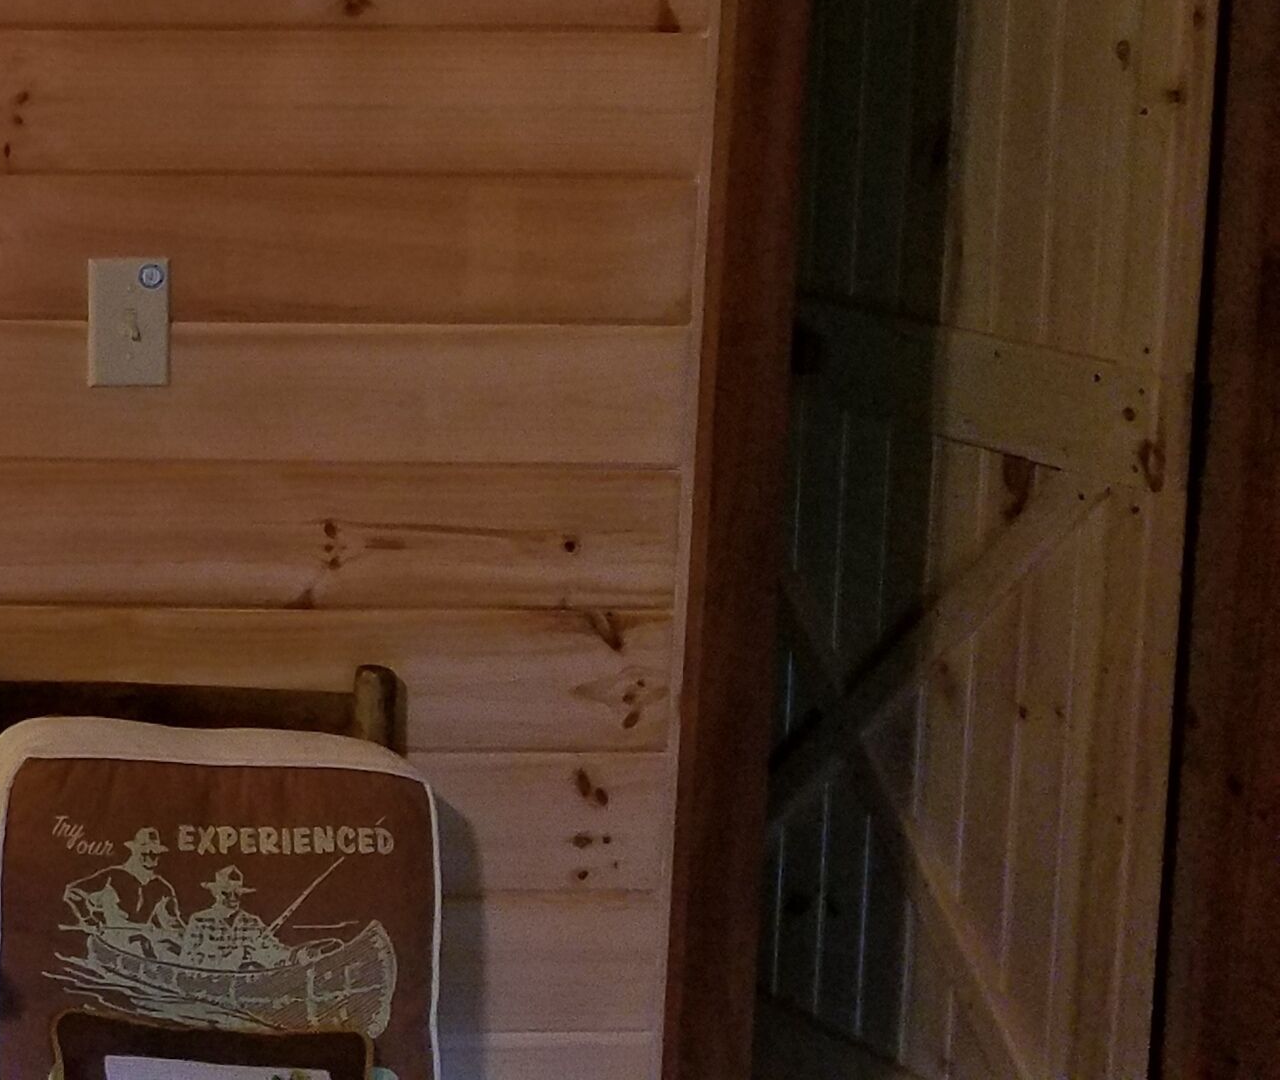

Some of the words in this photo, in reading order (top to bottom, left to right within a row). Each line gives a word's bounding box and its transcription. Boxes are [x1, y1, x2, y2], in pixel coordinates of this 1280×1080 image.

[51, 815, 84, 850] Try
[176, 823, 395, 856] EXPERIENCED
[75, 838, 115, 857] our
